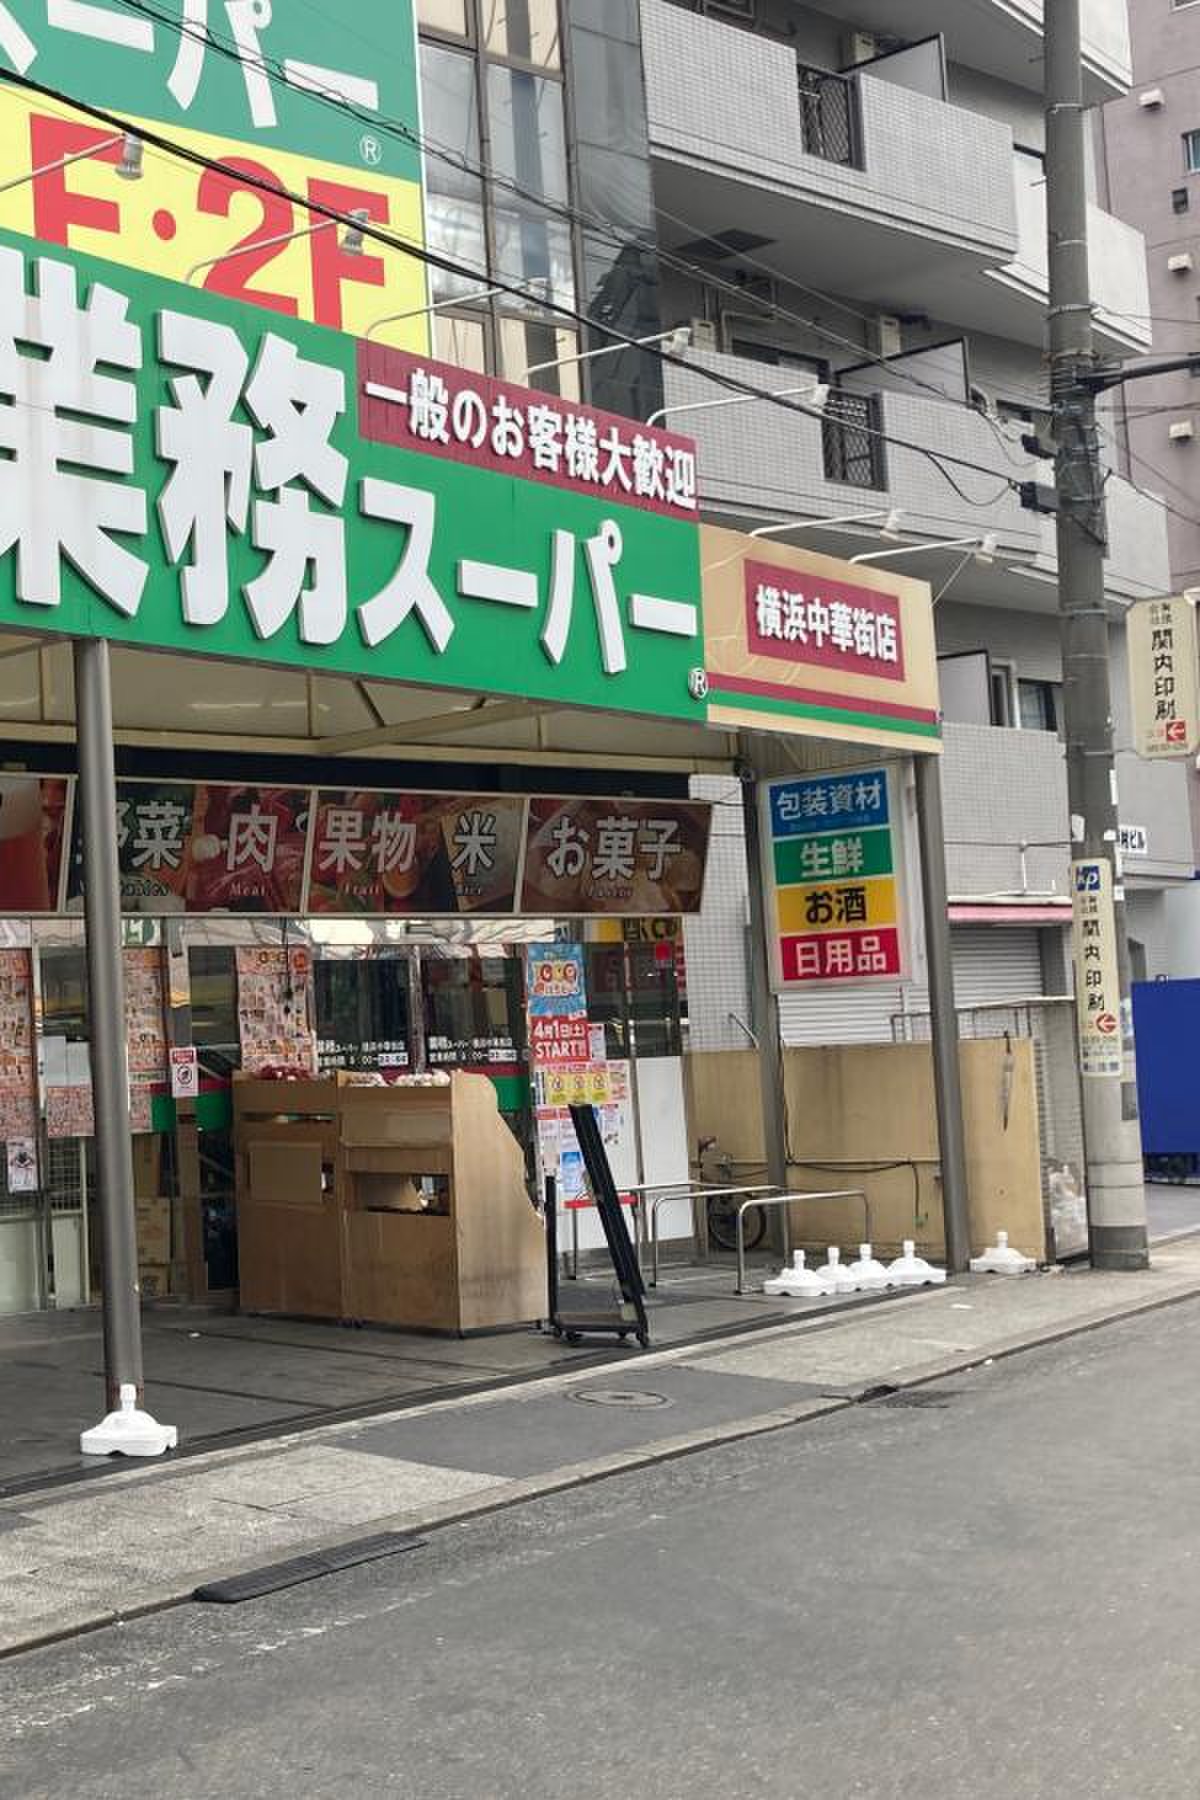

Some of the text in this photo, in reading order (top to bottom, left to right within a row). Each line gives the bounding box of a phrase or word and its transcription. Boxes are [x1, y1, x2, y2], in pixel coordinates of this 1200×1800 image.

[364, 367, 697, 511] 一般のお客様大歓迎
[755, 583, 898, 663] 横浜中華街店
[1151, 628, 1176, 721] 関内印刷
[776, 779, 881, 821] 包装資材
[226, 803, 279, 874] 肉
[318, 808, 418, 874] 果物
[451, 811, 497, 876] 米
[546, 814, 684, 882] お菓子
[800, 836, 864, 878] 生鮮
[804, 886, 868, 924] お酒
[795, 935, 888, 975] 日用品
